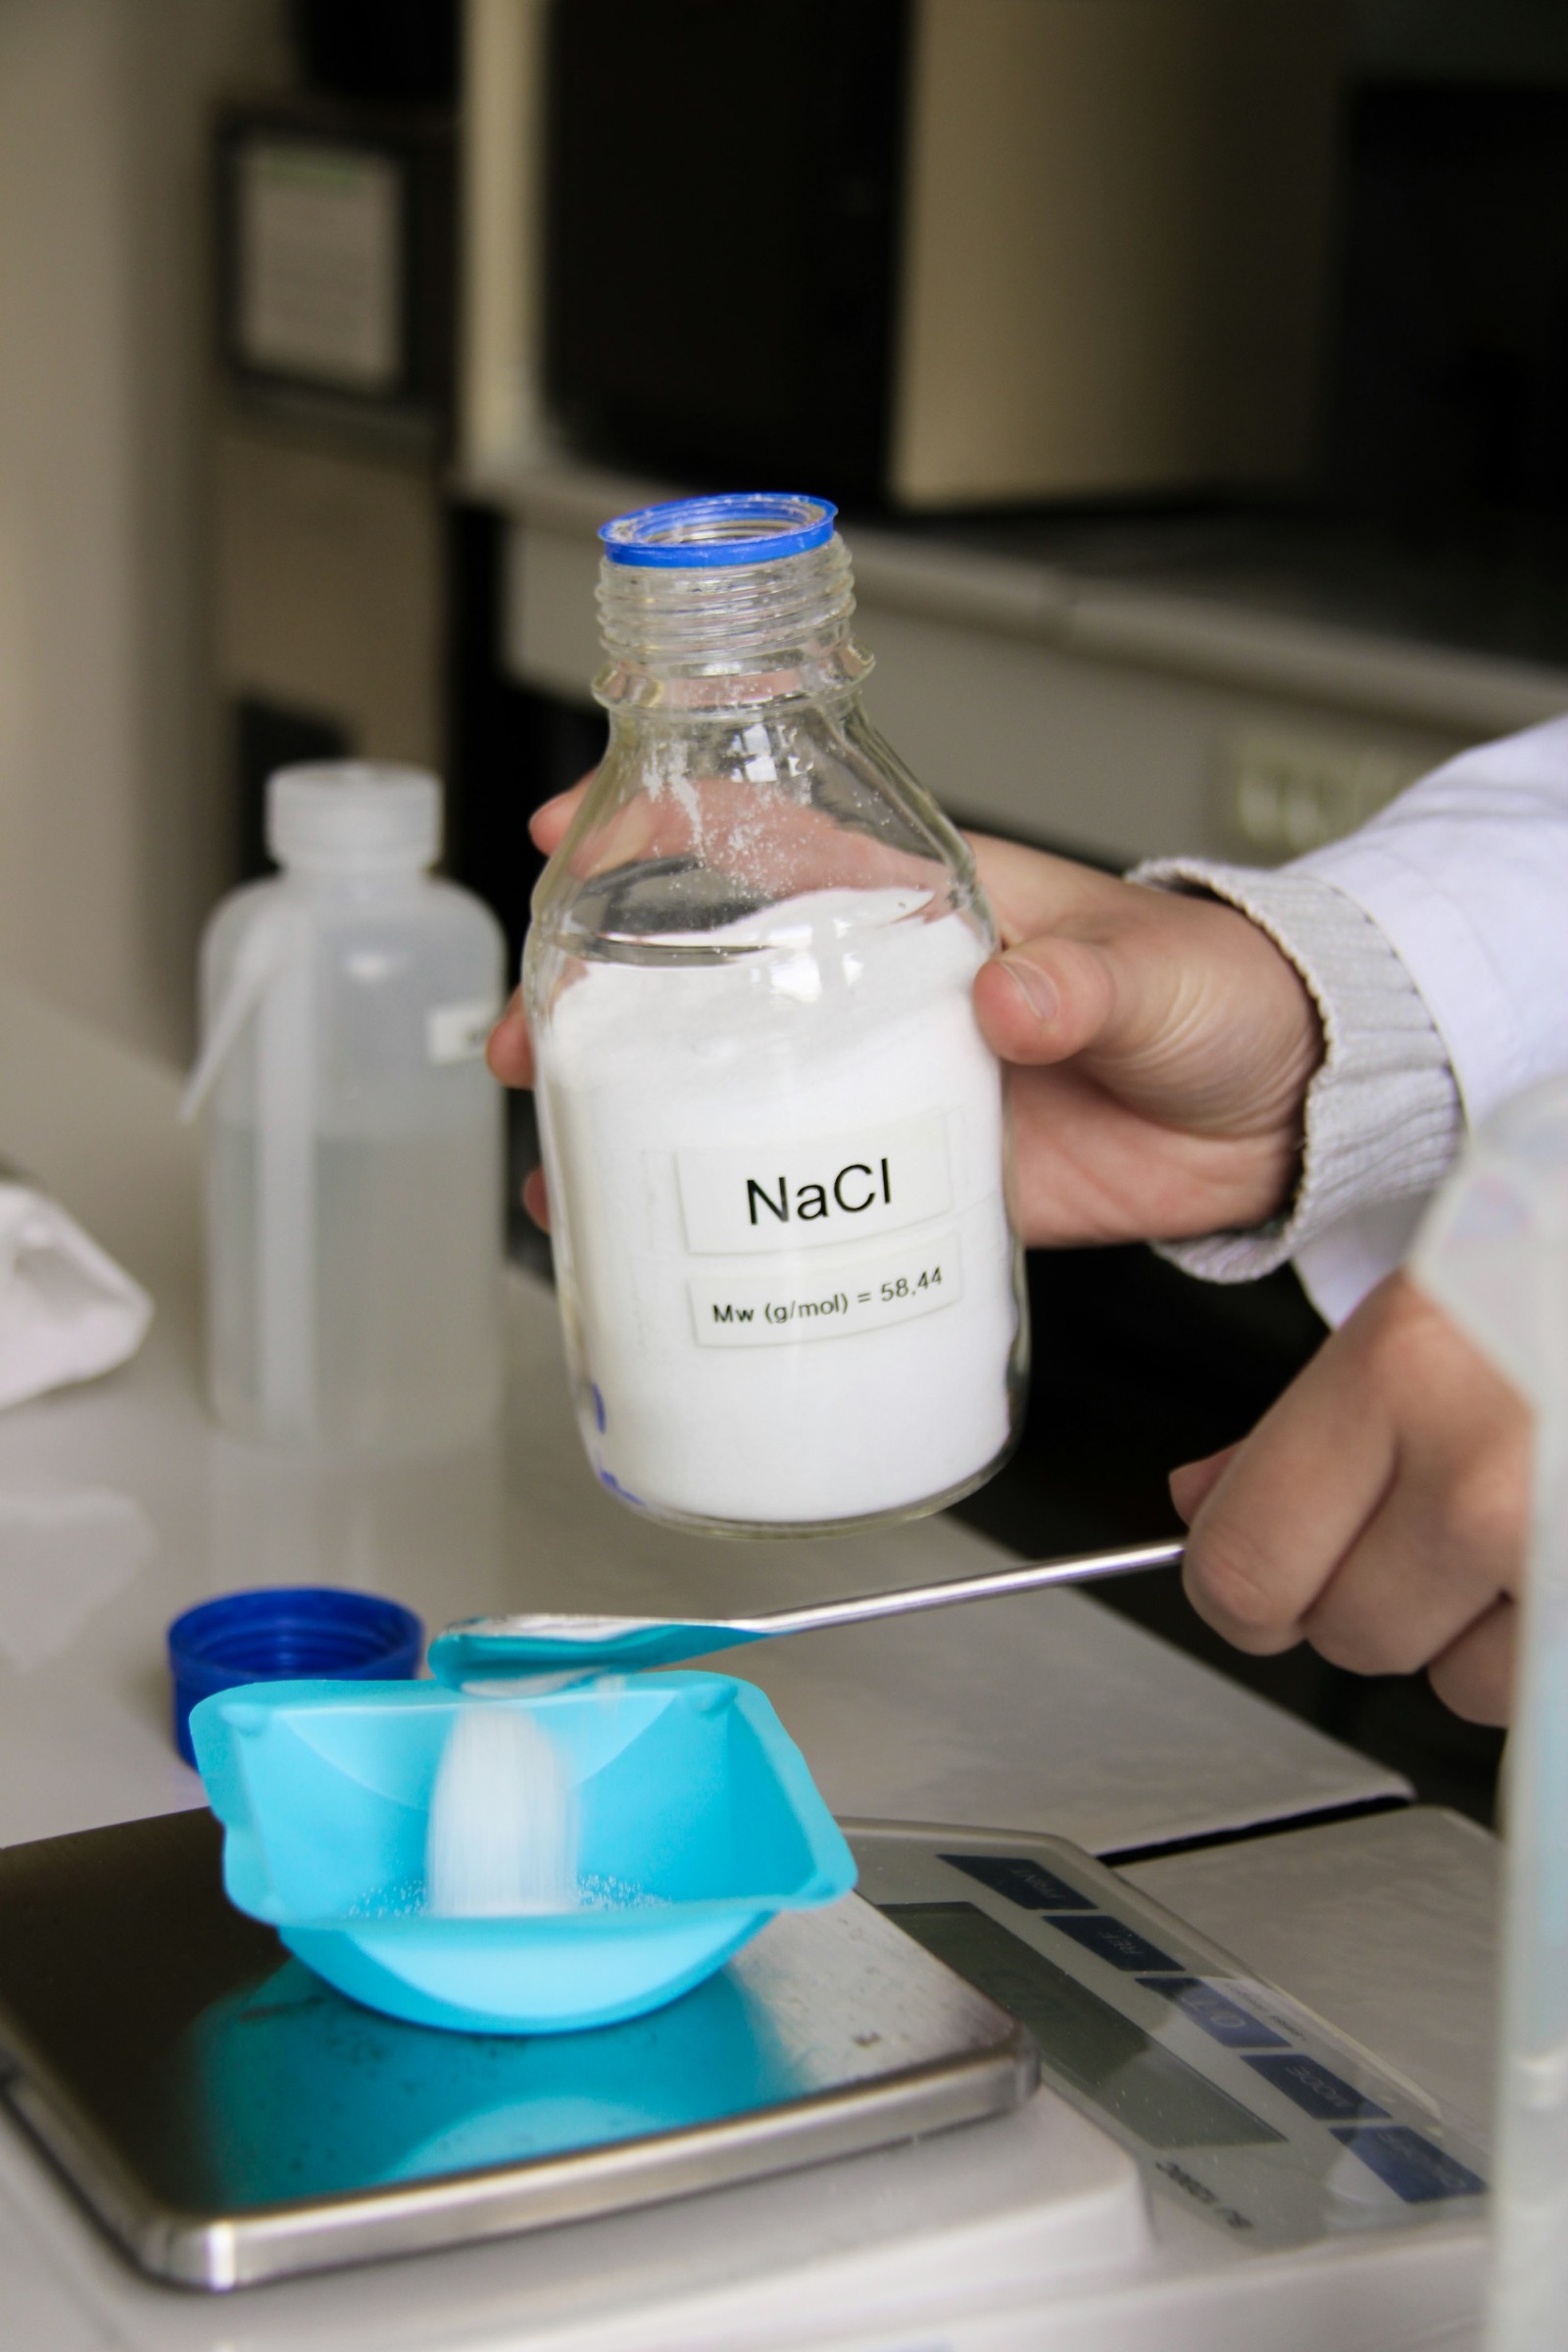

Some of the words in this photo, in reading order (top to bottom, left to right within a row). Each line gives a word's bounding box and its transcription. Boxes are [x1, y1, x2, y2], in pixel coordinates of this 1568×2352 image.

[746, 1156, 892, 1226] NaCl
[711, 1303, 755, 1324] Mw
[763, 1293, 849, 1325] (g/mol)
[857, 1292, 871, 1303] =
